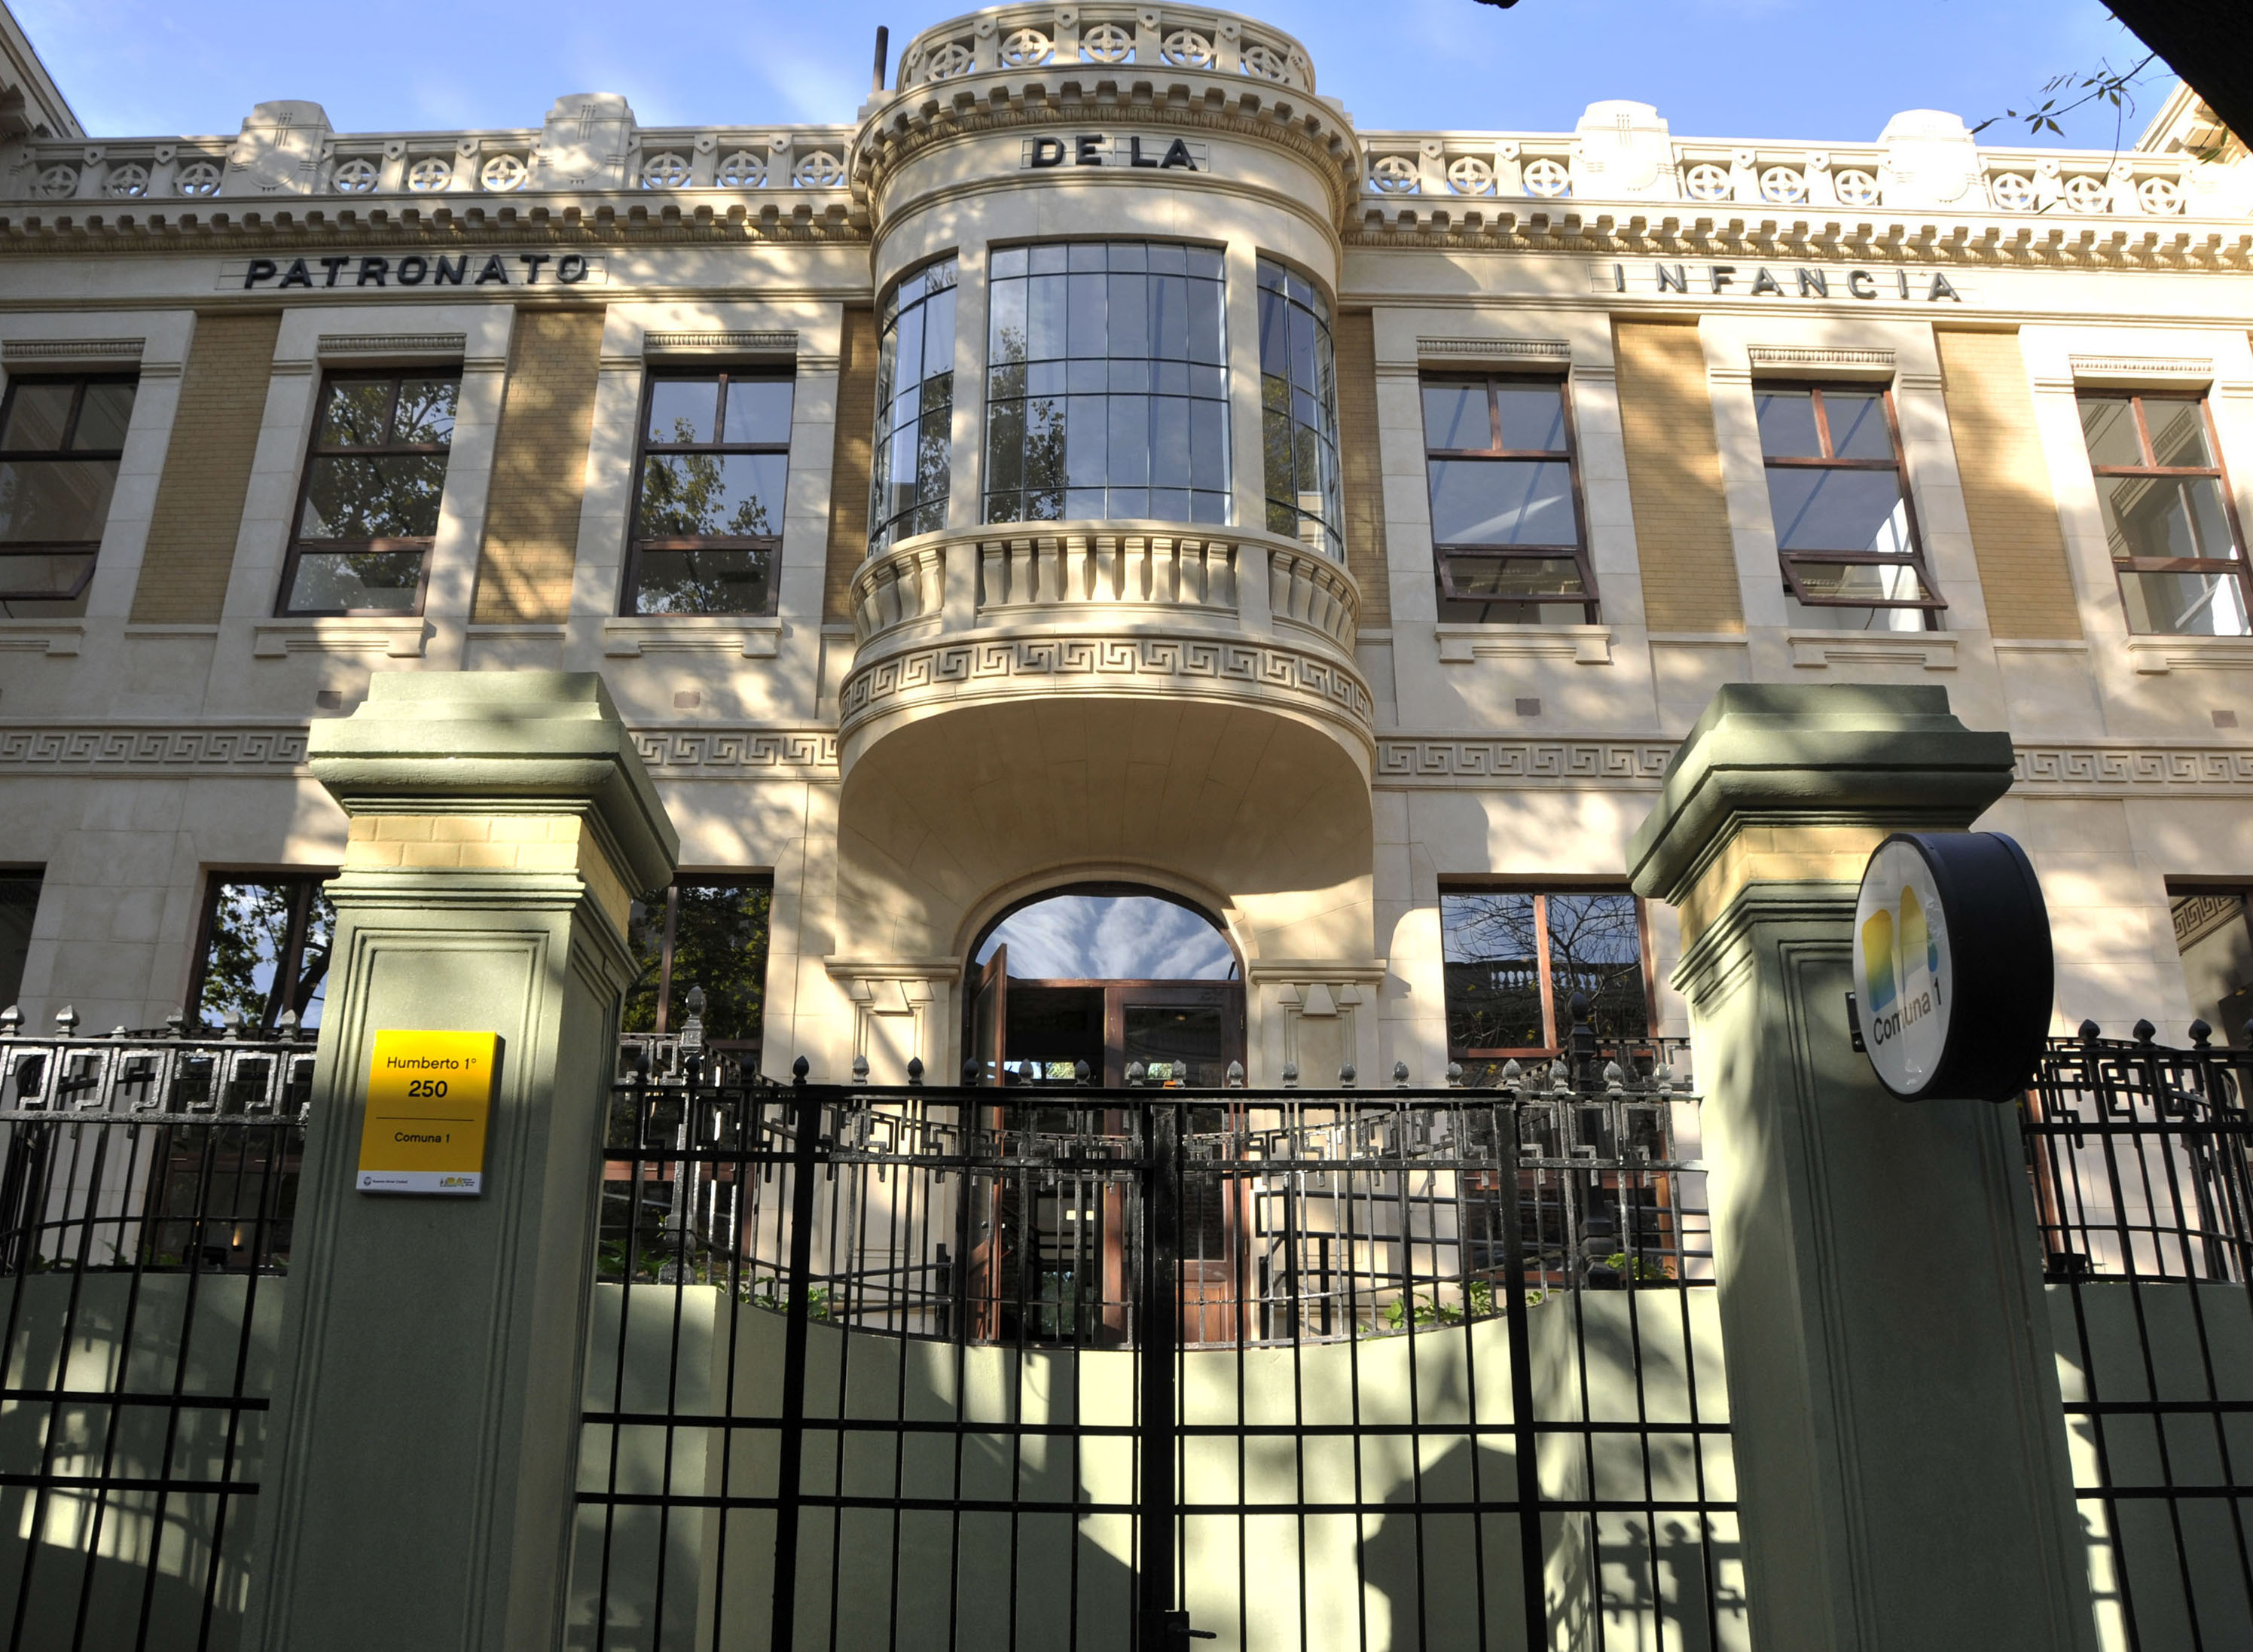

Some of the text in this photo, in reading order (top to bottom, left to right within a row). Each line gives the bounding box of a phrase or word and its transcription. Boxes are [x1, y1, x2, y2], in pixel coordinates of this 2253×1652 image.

[1031, 133, 1198, 171] DE LA
[244, 254, 588, 289] PATRONATO
[1613, 261, 1962, 302] INFANCIA
[1873, 976, 1942, 1046] Comuna 1
[386, 1056, 459, 1070] Humberto
[408, 1079, 448, 1098] 250
[394, 1131, 450, 1144] Comuna 1
